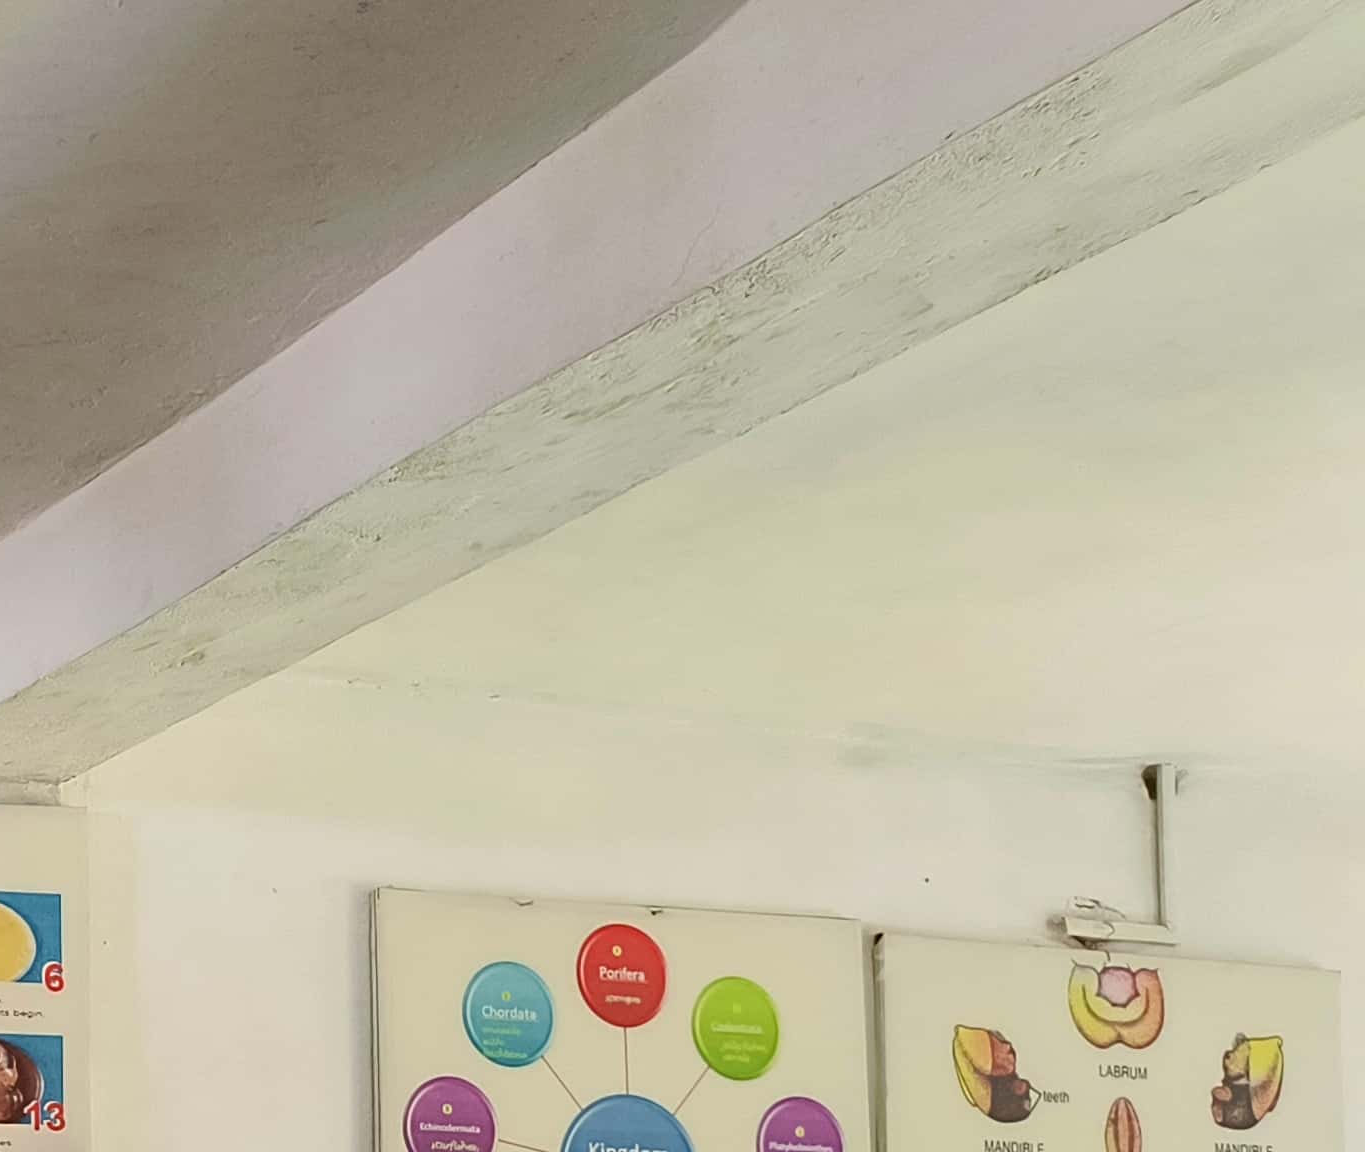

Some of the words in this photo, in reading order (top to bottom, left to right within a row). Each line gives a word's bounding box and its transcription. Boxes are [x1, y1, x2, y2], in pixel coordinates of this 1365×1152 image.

[43, 963, 65, 992] 6
[599, 966, 645, 983] Porifera
[482, 1005, 537, 1021] Chordata
[1099, 1064, 1147, 1080] LABRUM
[1043, 1089, 1069, 1104] teeth
[23, 1100, 66, 1132] 13
